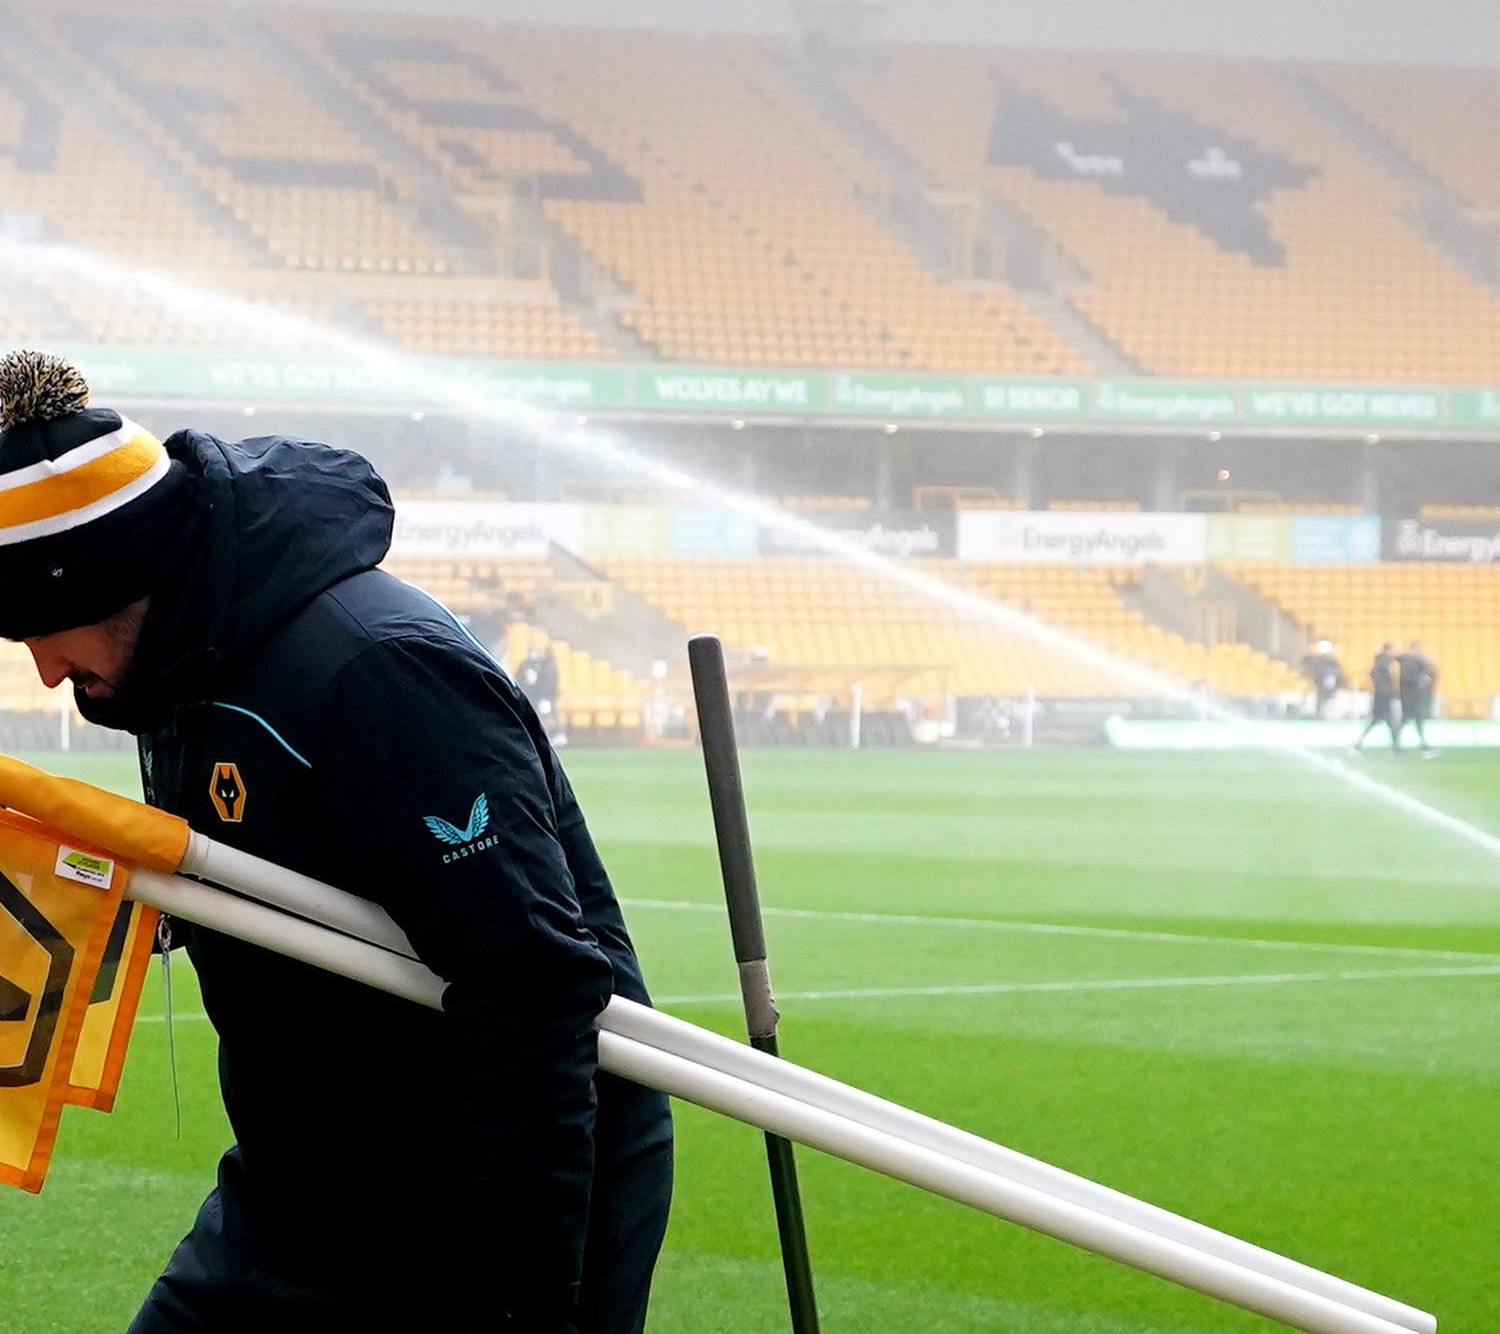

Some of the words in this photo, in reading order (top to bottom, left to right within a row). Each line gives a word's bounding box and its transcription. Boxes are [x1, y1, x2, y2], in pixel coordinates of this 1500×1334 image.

[654, 374, 742, 402] WOLVES
[1022, 527, 1166, 557] EnergyAngels
[442, 835, 499, 863] CASTORE
